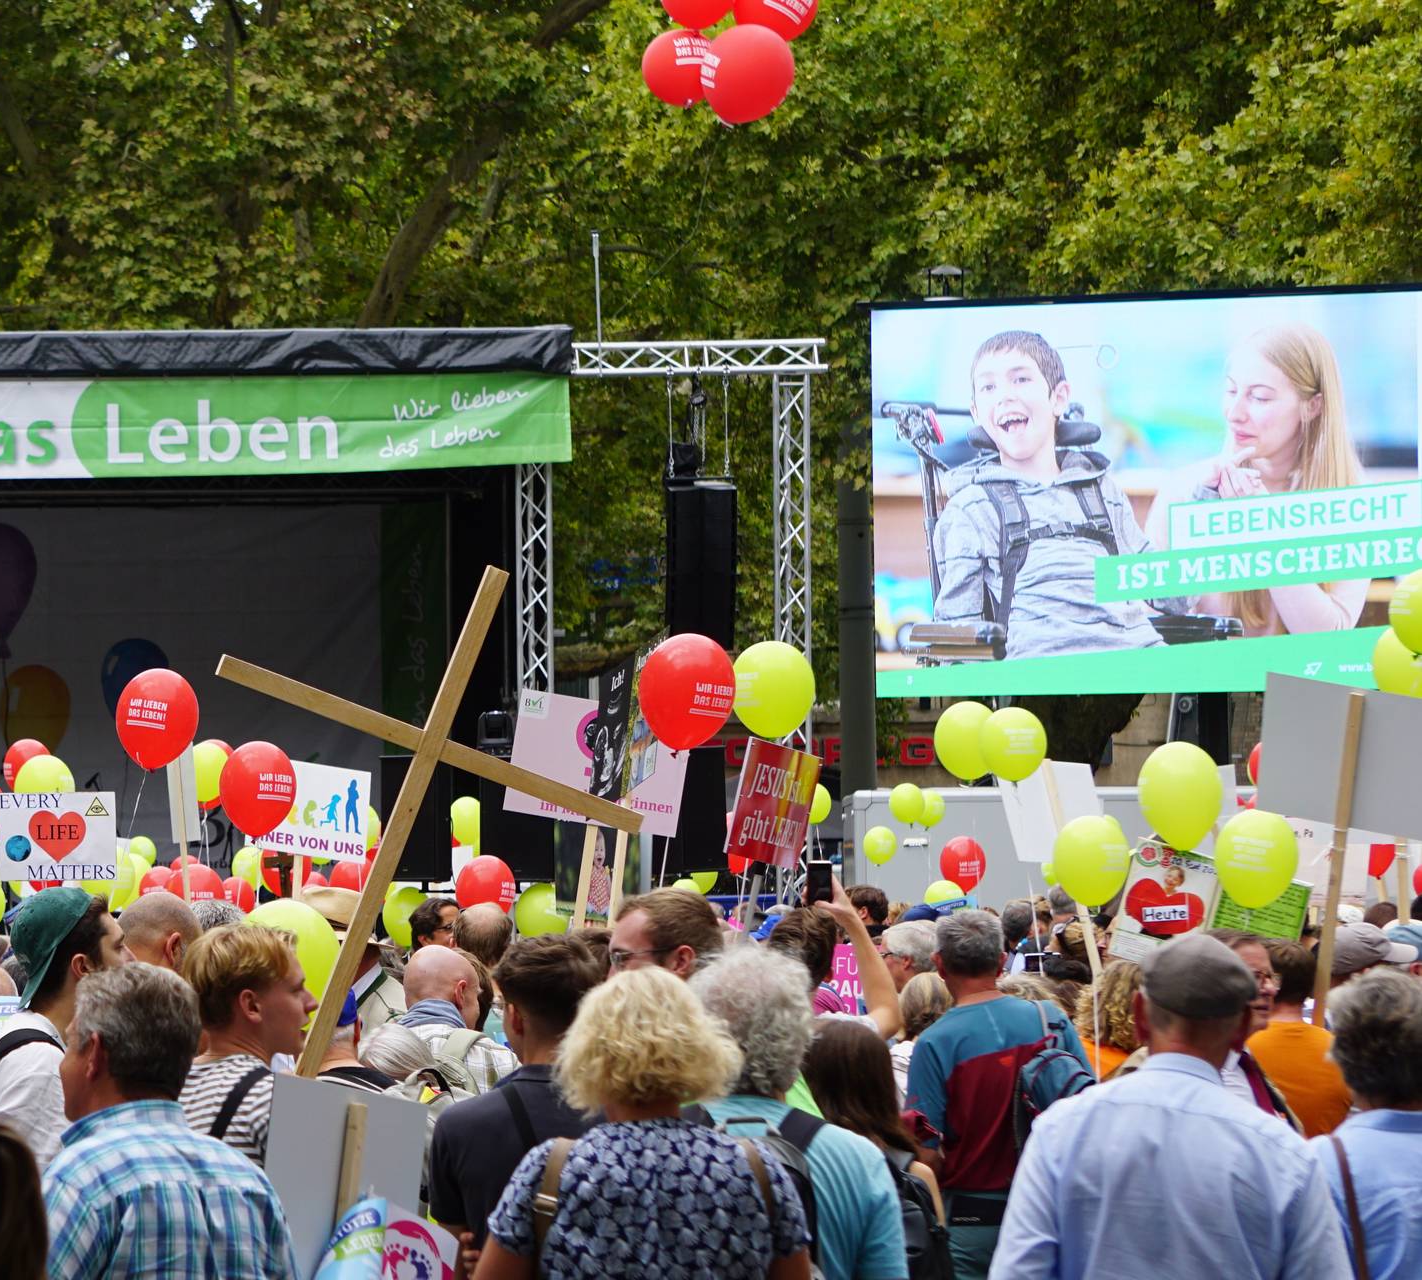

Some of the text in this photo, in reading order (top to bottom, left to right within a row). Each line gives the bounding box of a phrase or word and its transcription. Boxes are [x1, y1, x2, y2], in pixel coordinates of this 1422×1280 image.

[674, 38, 712, 49] WIR LIEBE
[676, 48, 692, 57] DAS
[393, 386, 529, 423] Wir lieben
[106, 400, 339, 464] Leben
[379, 425, 500, 459] das Leben
[1189, 493, 1408, 538] LEBENSRECHT
[1117, 558, 1171, 591] IST
[696, 683, 712, 693] WIR
[130, 698, 168, 712] WIR LIEBEN
[694, 695, 710, 706] DAS
[128, 708, 166, 722] DAS LEBEN!
[259, 773, 292, 784] WIR LIEBEN
[747, 763, 790, 800] JESUS
[259, 783, 273, 792] DAS
[0, 793, 63, 810] EVERY
[36, 824, 80, 841] LIFE
[739, 810, 802, 849] gibt LEBEN
[299, 836, 329, 851] VON
[334, 841, 364, 856] UNS
[27, 864, 116, 881] MATTERS
[1143, 908, 1188, 921] Heute
